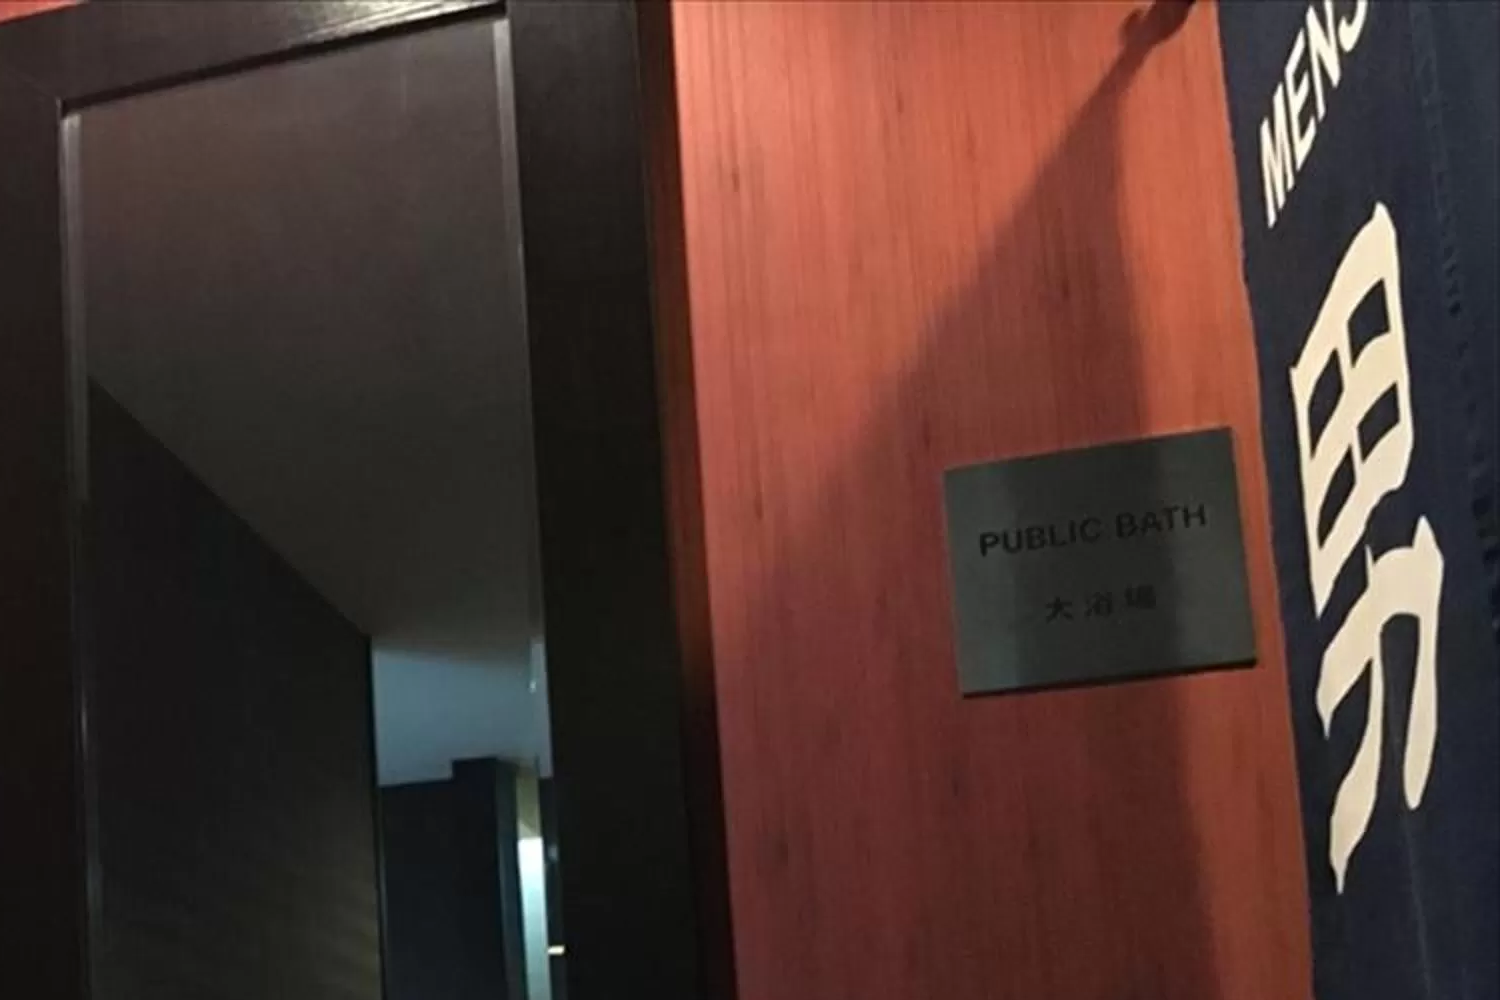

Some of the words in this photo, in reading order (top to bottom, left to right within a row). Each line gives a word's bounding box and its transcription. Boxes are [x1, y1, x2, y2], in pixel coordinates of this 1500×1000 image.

[979, 517, 1101, 557] PUBLIC
[1115, 503, 1206, 539] BATH
[1290, 202, 1444, 894] 男
